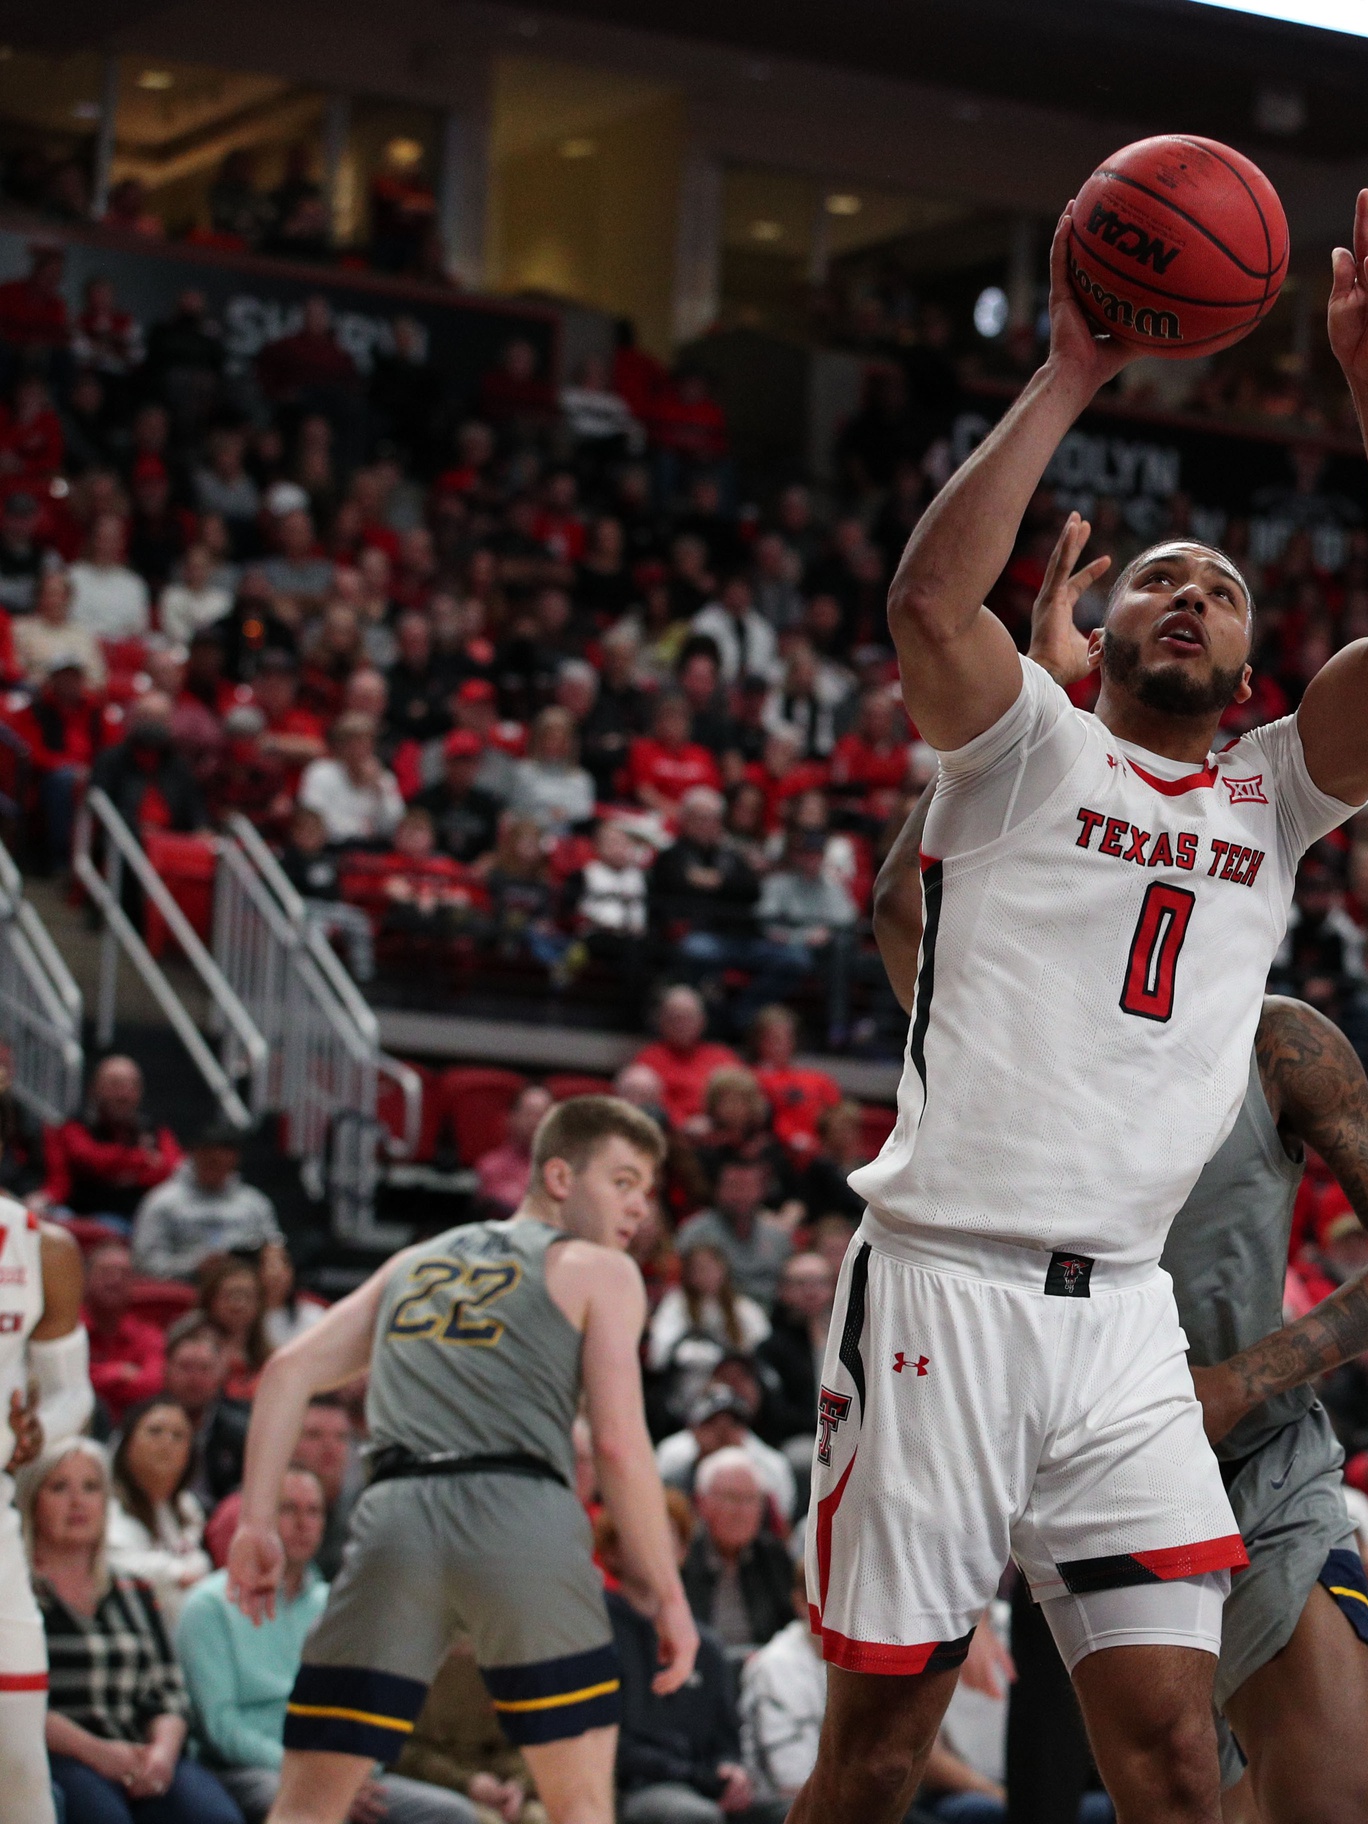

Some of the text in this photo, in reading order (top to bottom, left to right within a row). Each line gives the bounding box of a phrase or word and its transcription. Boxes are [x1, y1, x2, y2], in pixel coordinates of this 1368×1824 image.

[1086, 202, 1181, 275] NCAA
[1076, 807, 1265, 887] TEXAS TECH
[1119, 880, 1196, 1023] 0
[386, 1257, 524, 1348] 22
